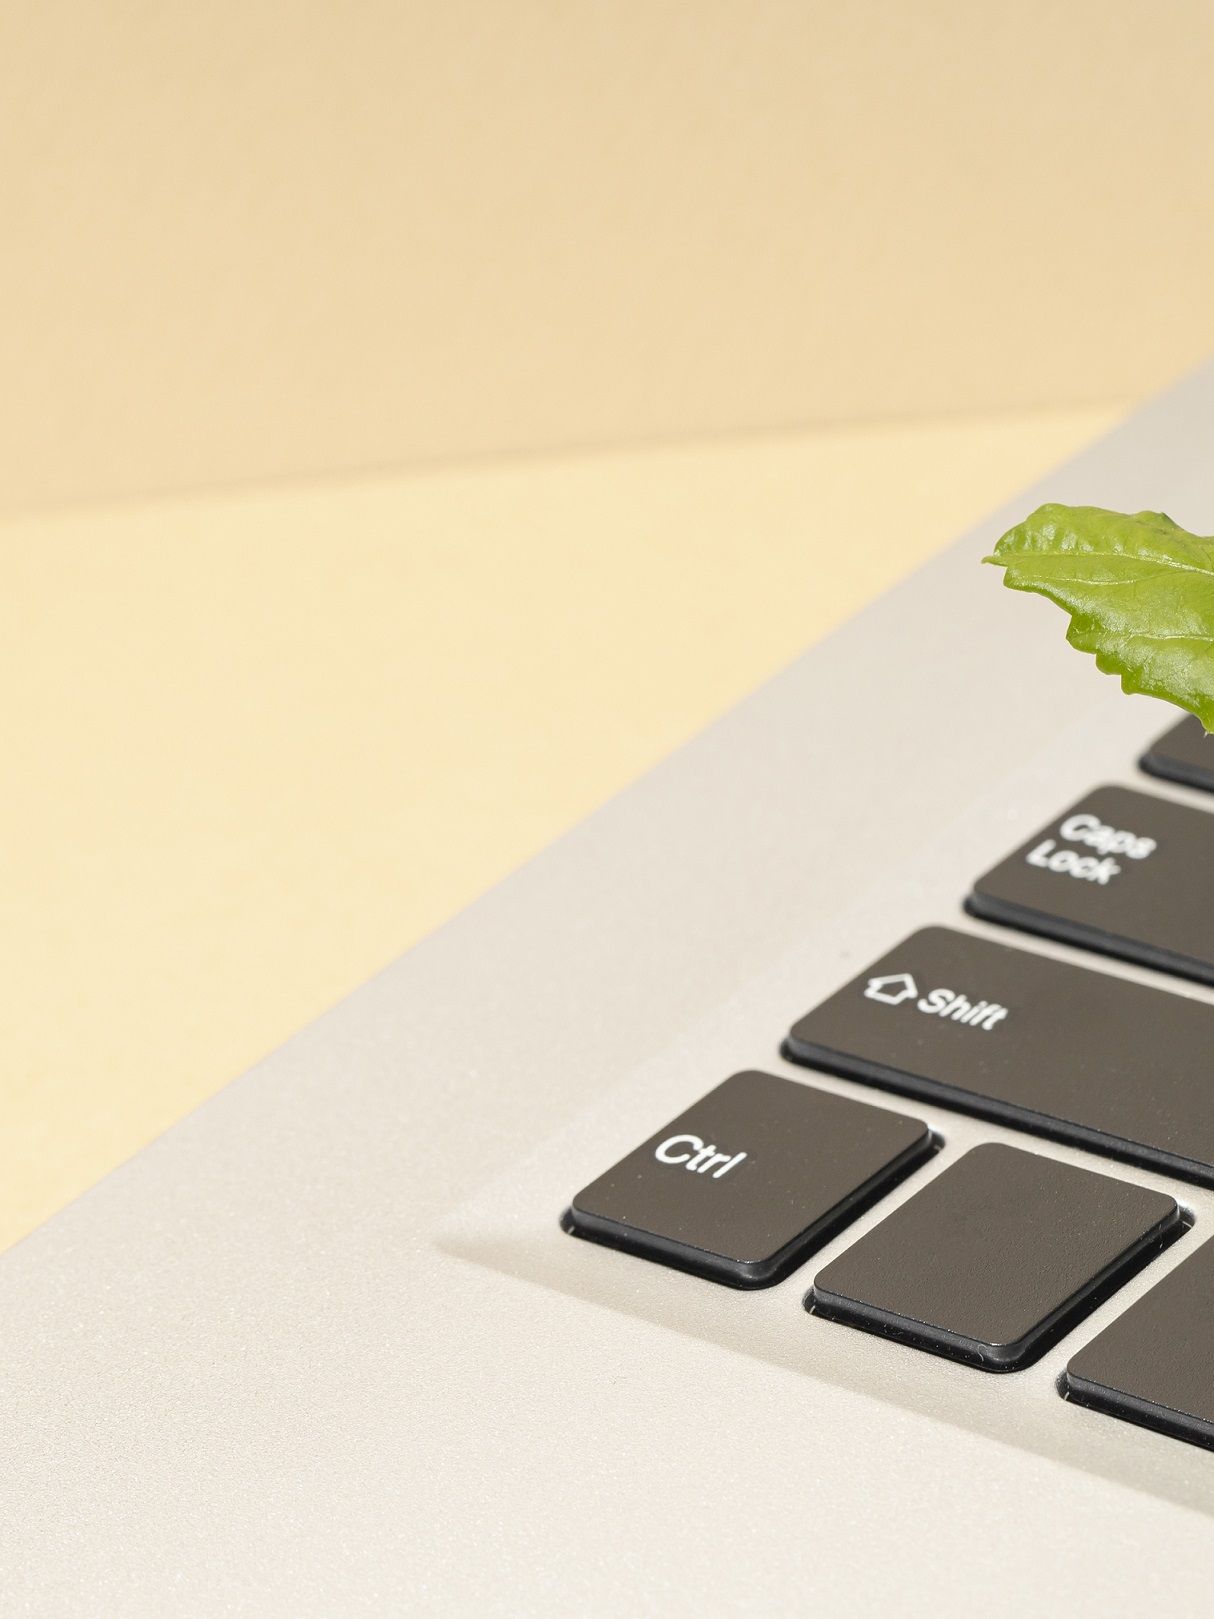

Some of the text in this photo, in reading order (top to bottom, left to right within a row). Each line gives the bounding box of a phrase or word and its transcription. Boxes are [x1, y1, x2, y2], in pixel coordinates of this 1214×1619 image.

[1060, 814, 1156, 859] Caps
[1026, 840, 1120, 884] Lock
[917, 989, 1008, 1031] Shift
[654, 1134, 748, 1179] Ctrl
